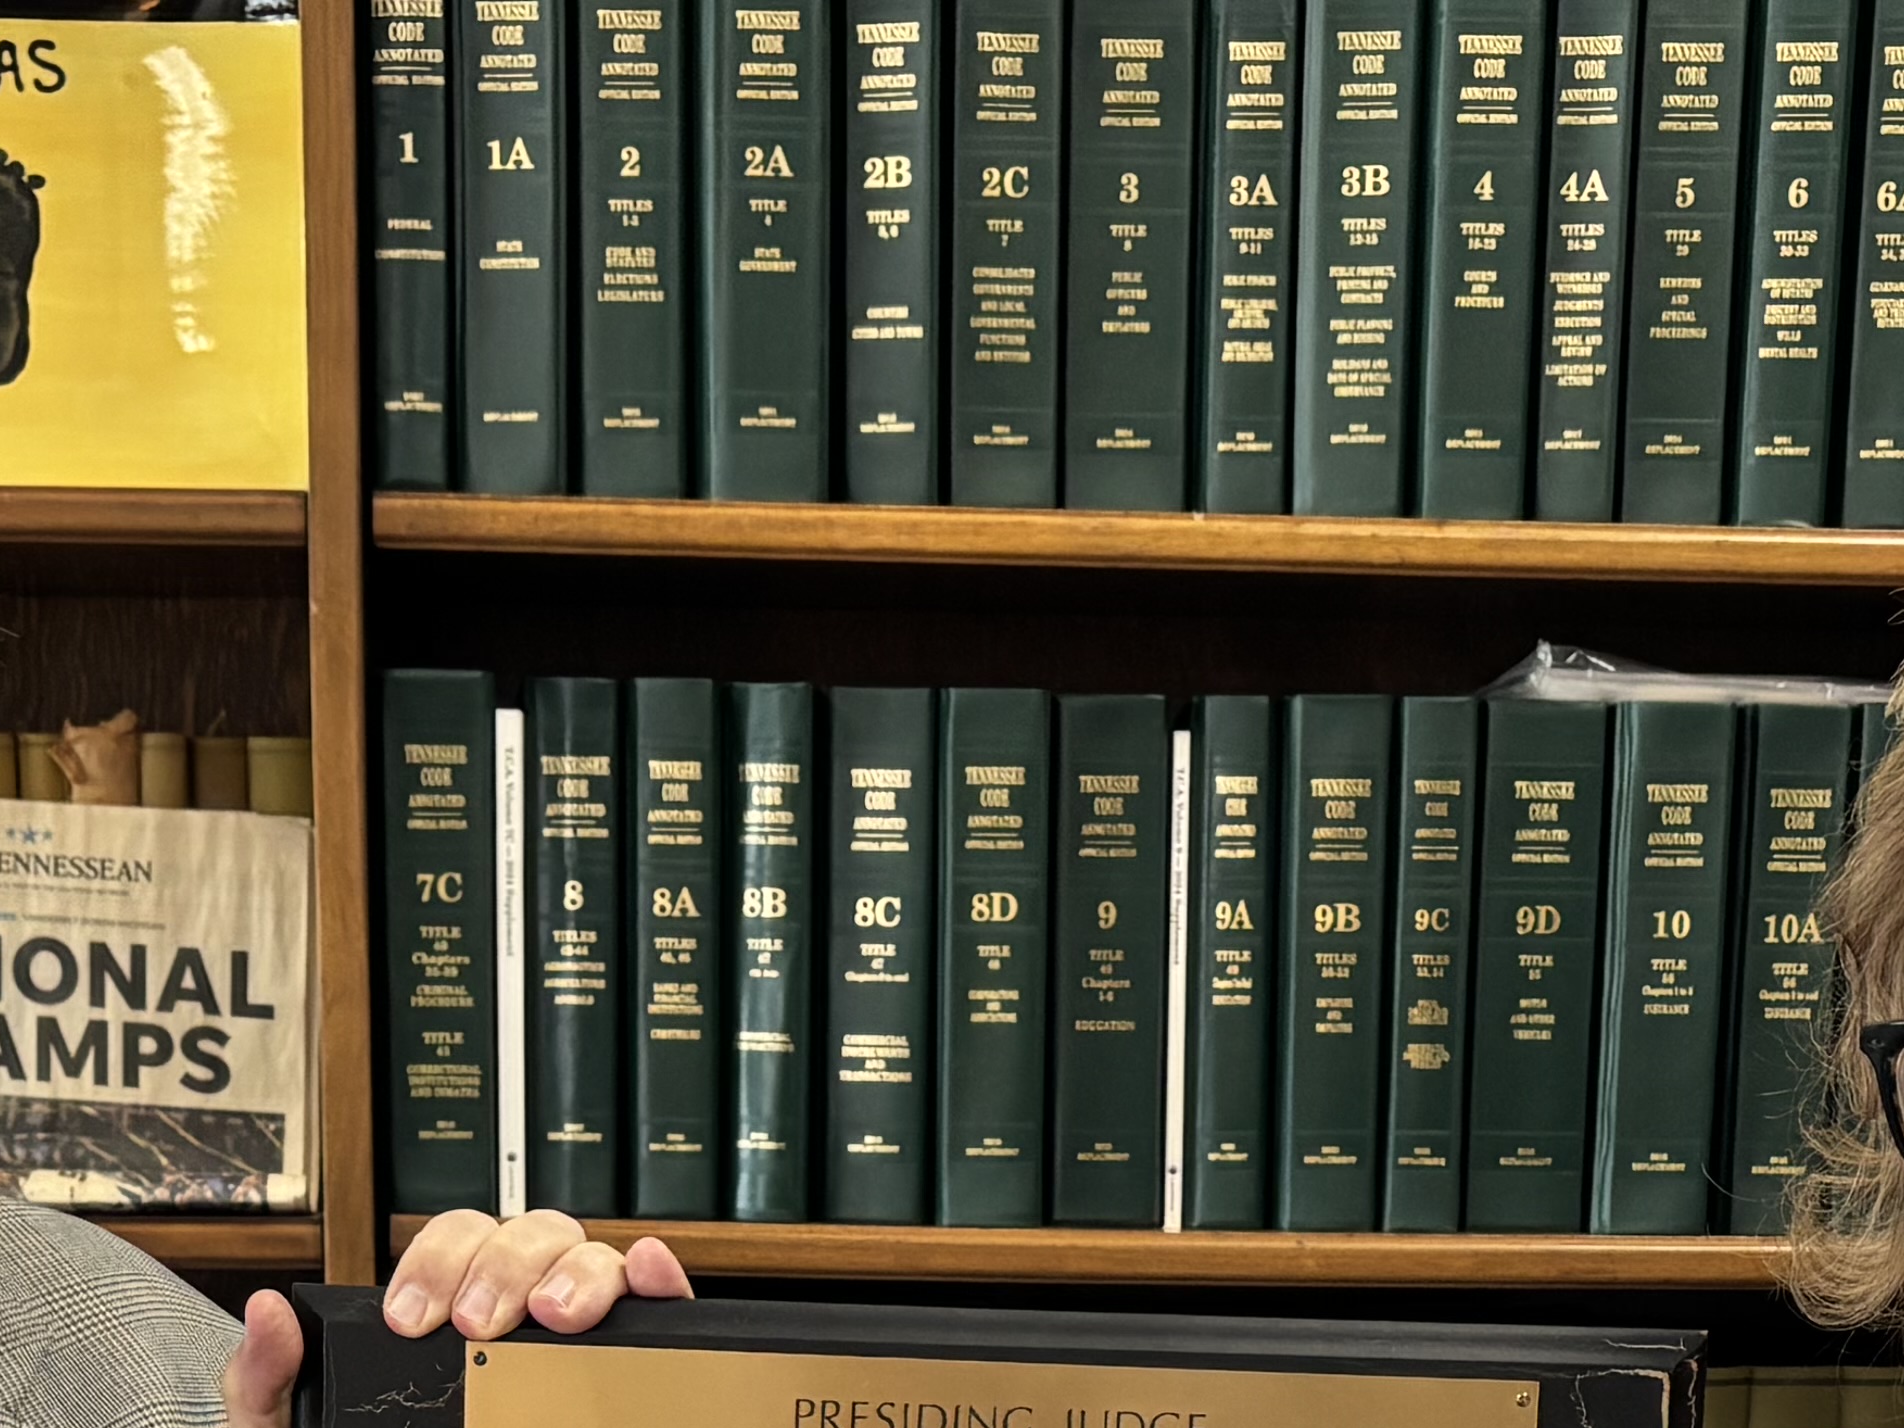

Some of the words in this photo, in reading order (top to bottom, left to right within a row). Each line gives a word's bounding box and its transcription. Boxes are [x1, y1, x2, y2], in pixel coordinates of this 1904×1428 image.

[398, 133, 418, 163] 1
[487, 138, 534, 170] 1A
[744, 146, 793, 177] 2A
[864, 156, 912, 188] 2B
[982, 167, 1030, 198] 2C
[1341, 165, 1390, 197] 3B
[1559, 170, 1608, 202] 4A
[416, 873, 462, 902] 7C
[563, 881, 583, 910] 8
[653, 887, 700, 917] 8A
[743, 887, 787, 918] 8B
[971, 893, 1018, 922] 8D
[1315, 904, 1361, 933] 9B
[1516, 905, 1561, 934] 9D
[1652, 910, 1691, 940] 10
[1763, 914, 1821, 944] 10A
